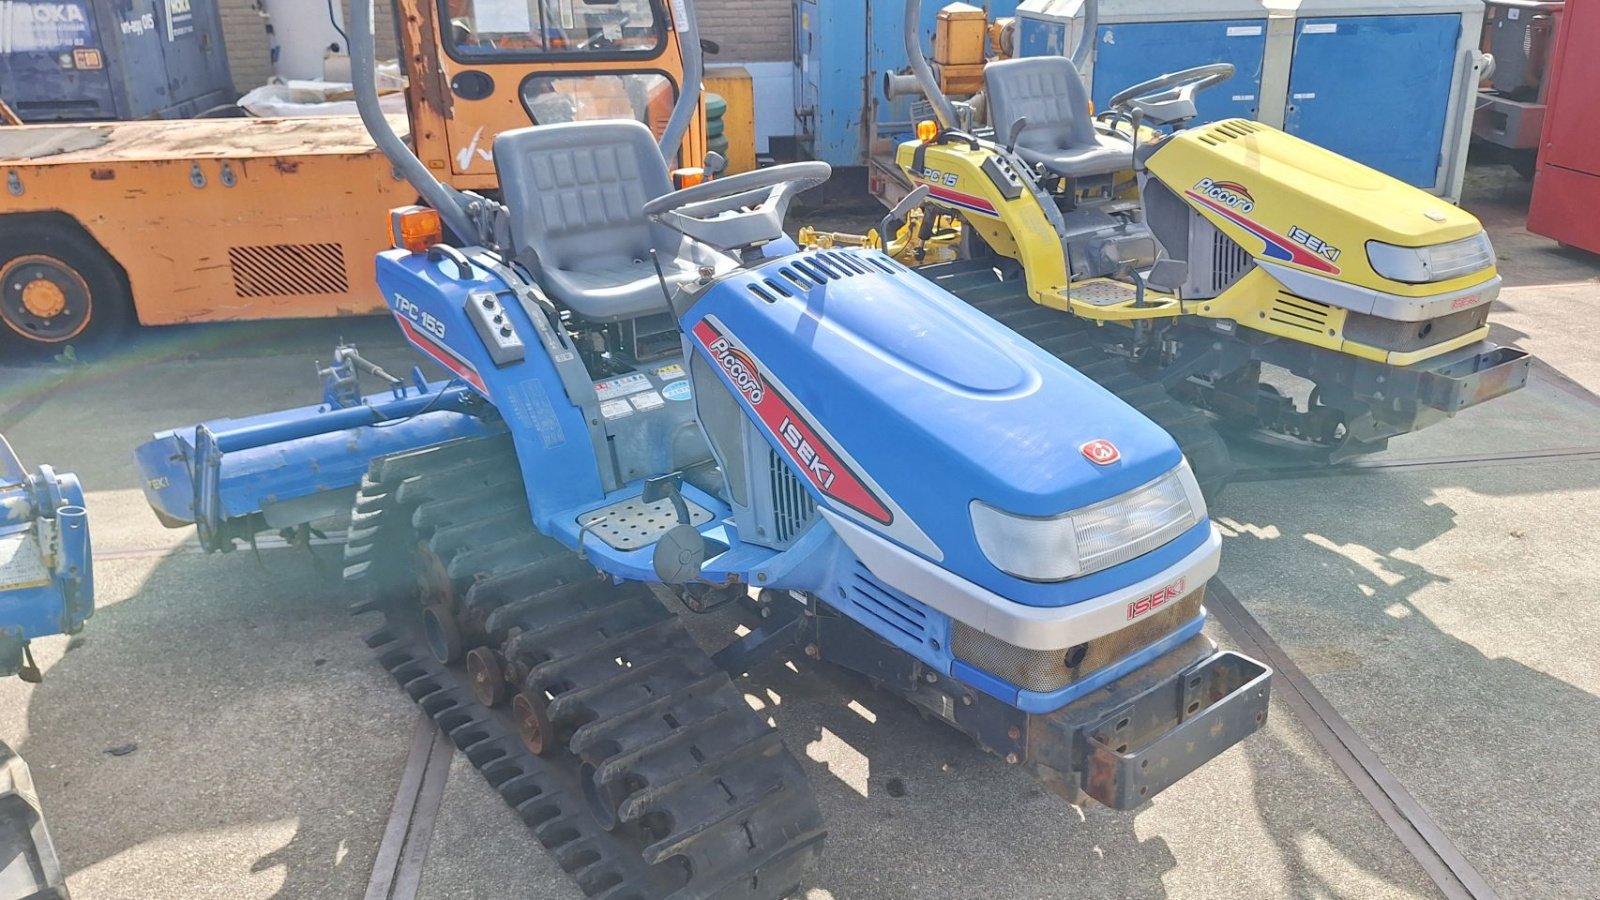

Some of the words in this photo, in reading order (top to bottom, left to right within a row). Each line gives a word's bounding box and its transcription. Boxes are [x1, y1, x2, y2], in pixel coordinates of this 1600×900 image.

[922, 168, 941, 183] PC
[941, 172, 959, 187] 15
[1193, 177, 1254, 214] Piccoro
[1287, 225, 1341, 262] ISEKI
[394, 292, 419, 320] TPC
[421, 311, 446, 339] 153
[711, 338, 763, 404] Piccoro
[779, 416, 836, 489] ISEKI
[1127, 576, 1187, 621] ISEKI
